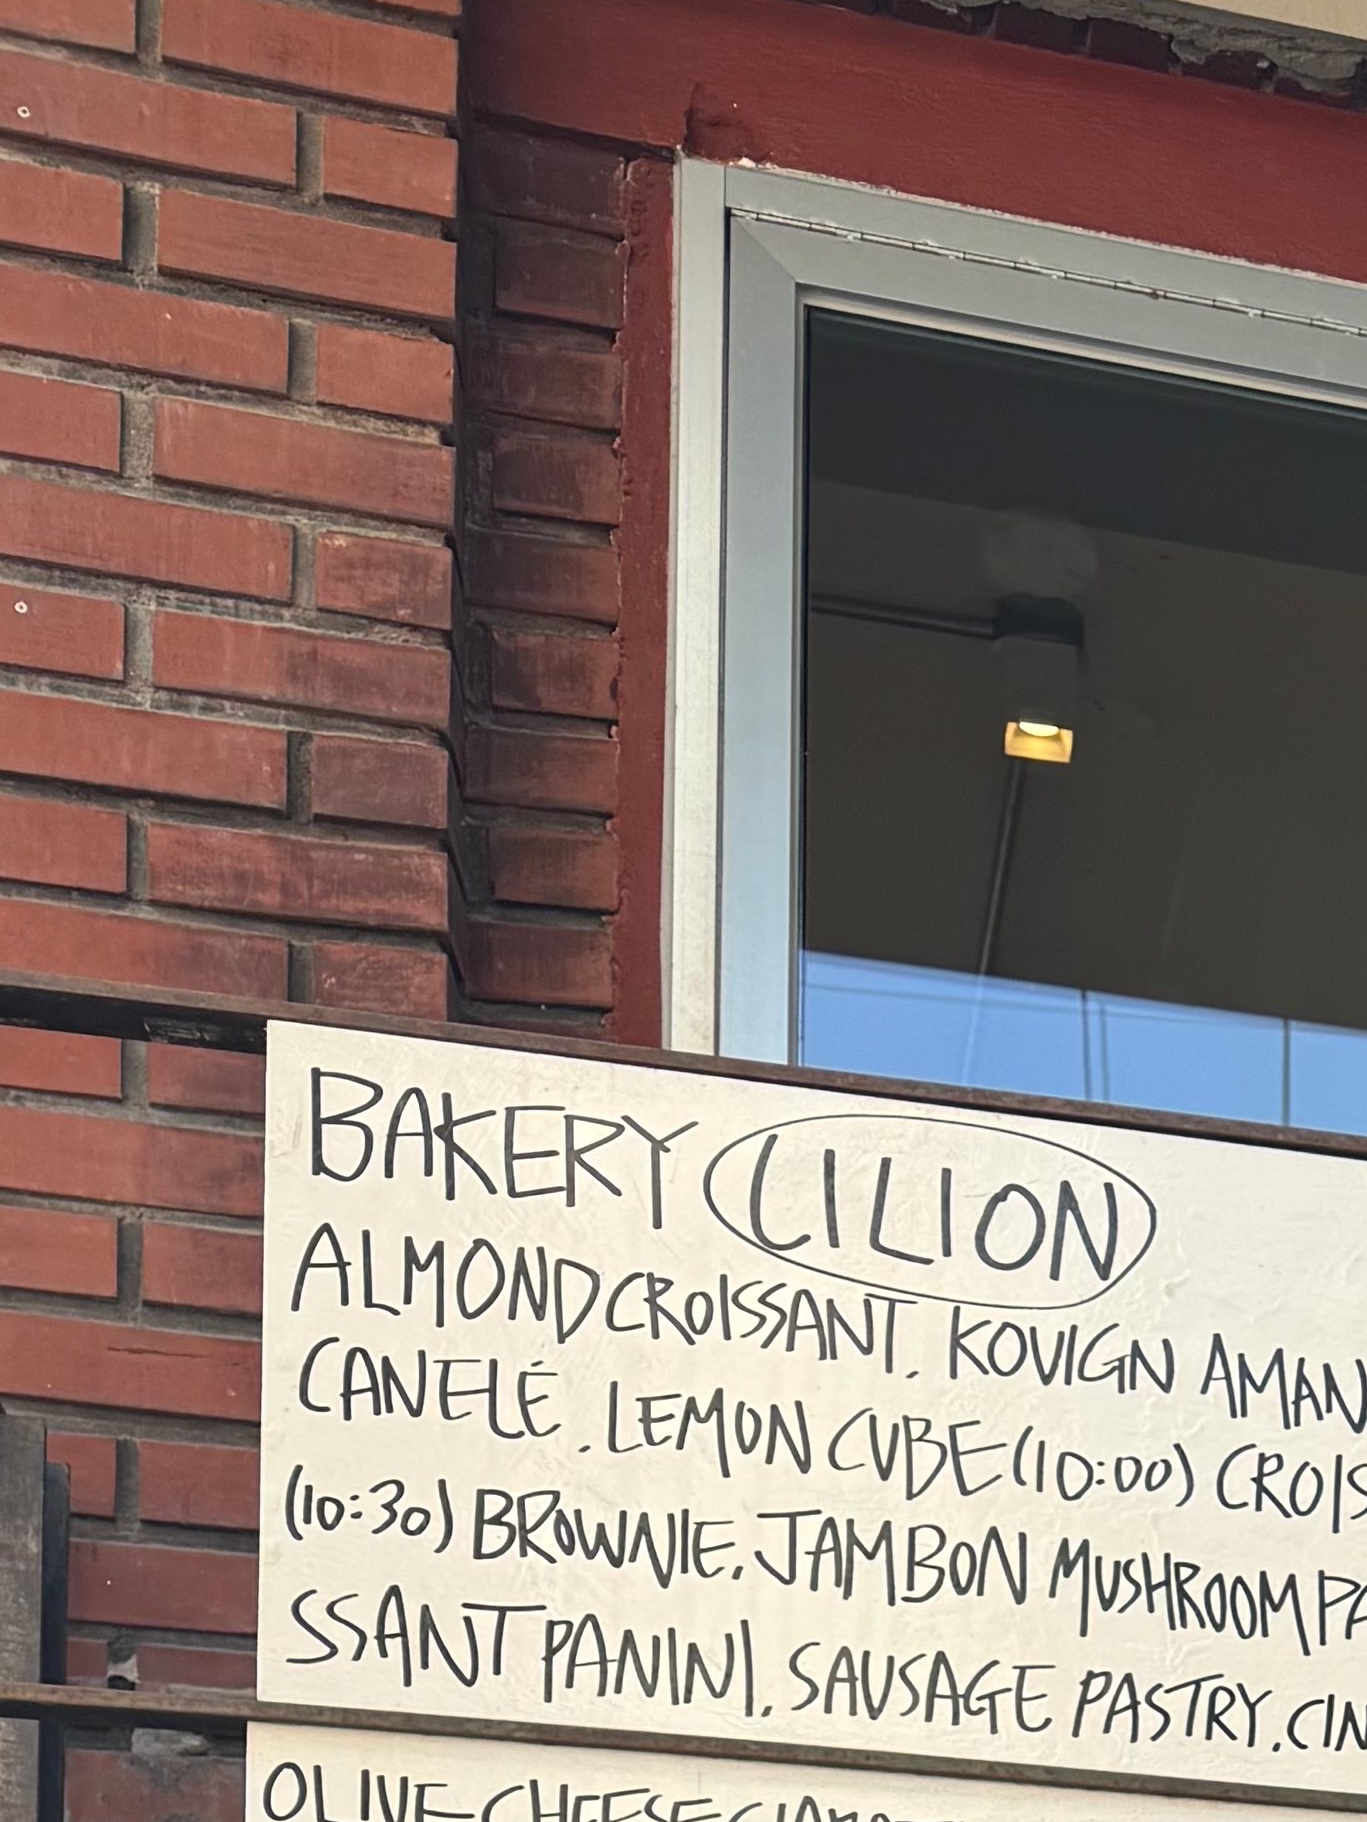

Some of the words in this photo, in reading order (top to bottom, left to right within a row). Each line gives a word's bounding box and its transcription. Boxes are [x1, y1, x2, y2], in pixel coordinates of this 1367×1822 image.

[309, 1065, 700, 1231] BAKERY
[748, 1132, 1119, 1283] LILION
[607, 1379, 813, 1480] LEMON
[284, 1463, 455, 1555] (10:30)
[753, 1508, 1028, 1608] JAMBON
[1047, 1536, 1312, 1658] MUSHROOM
